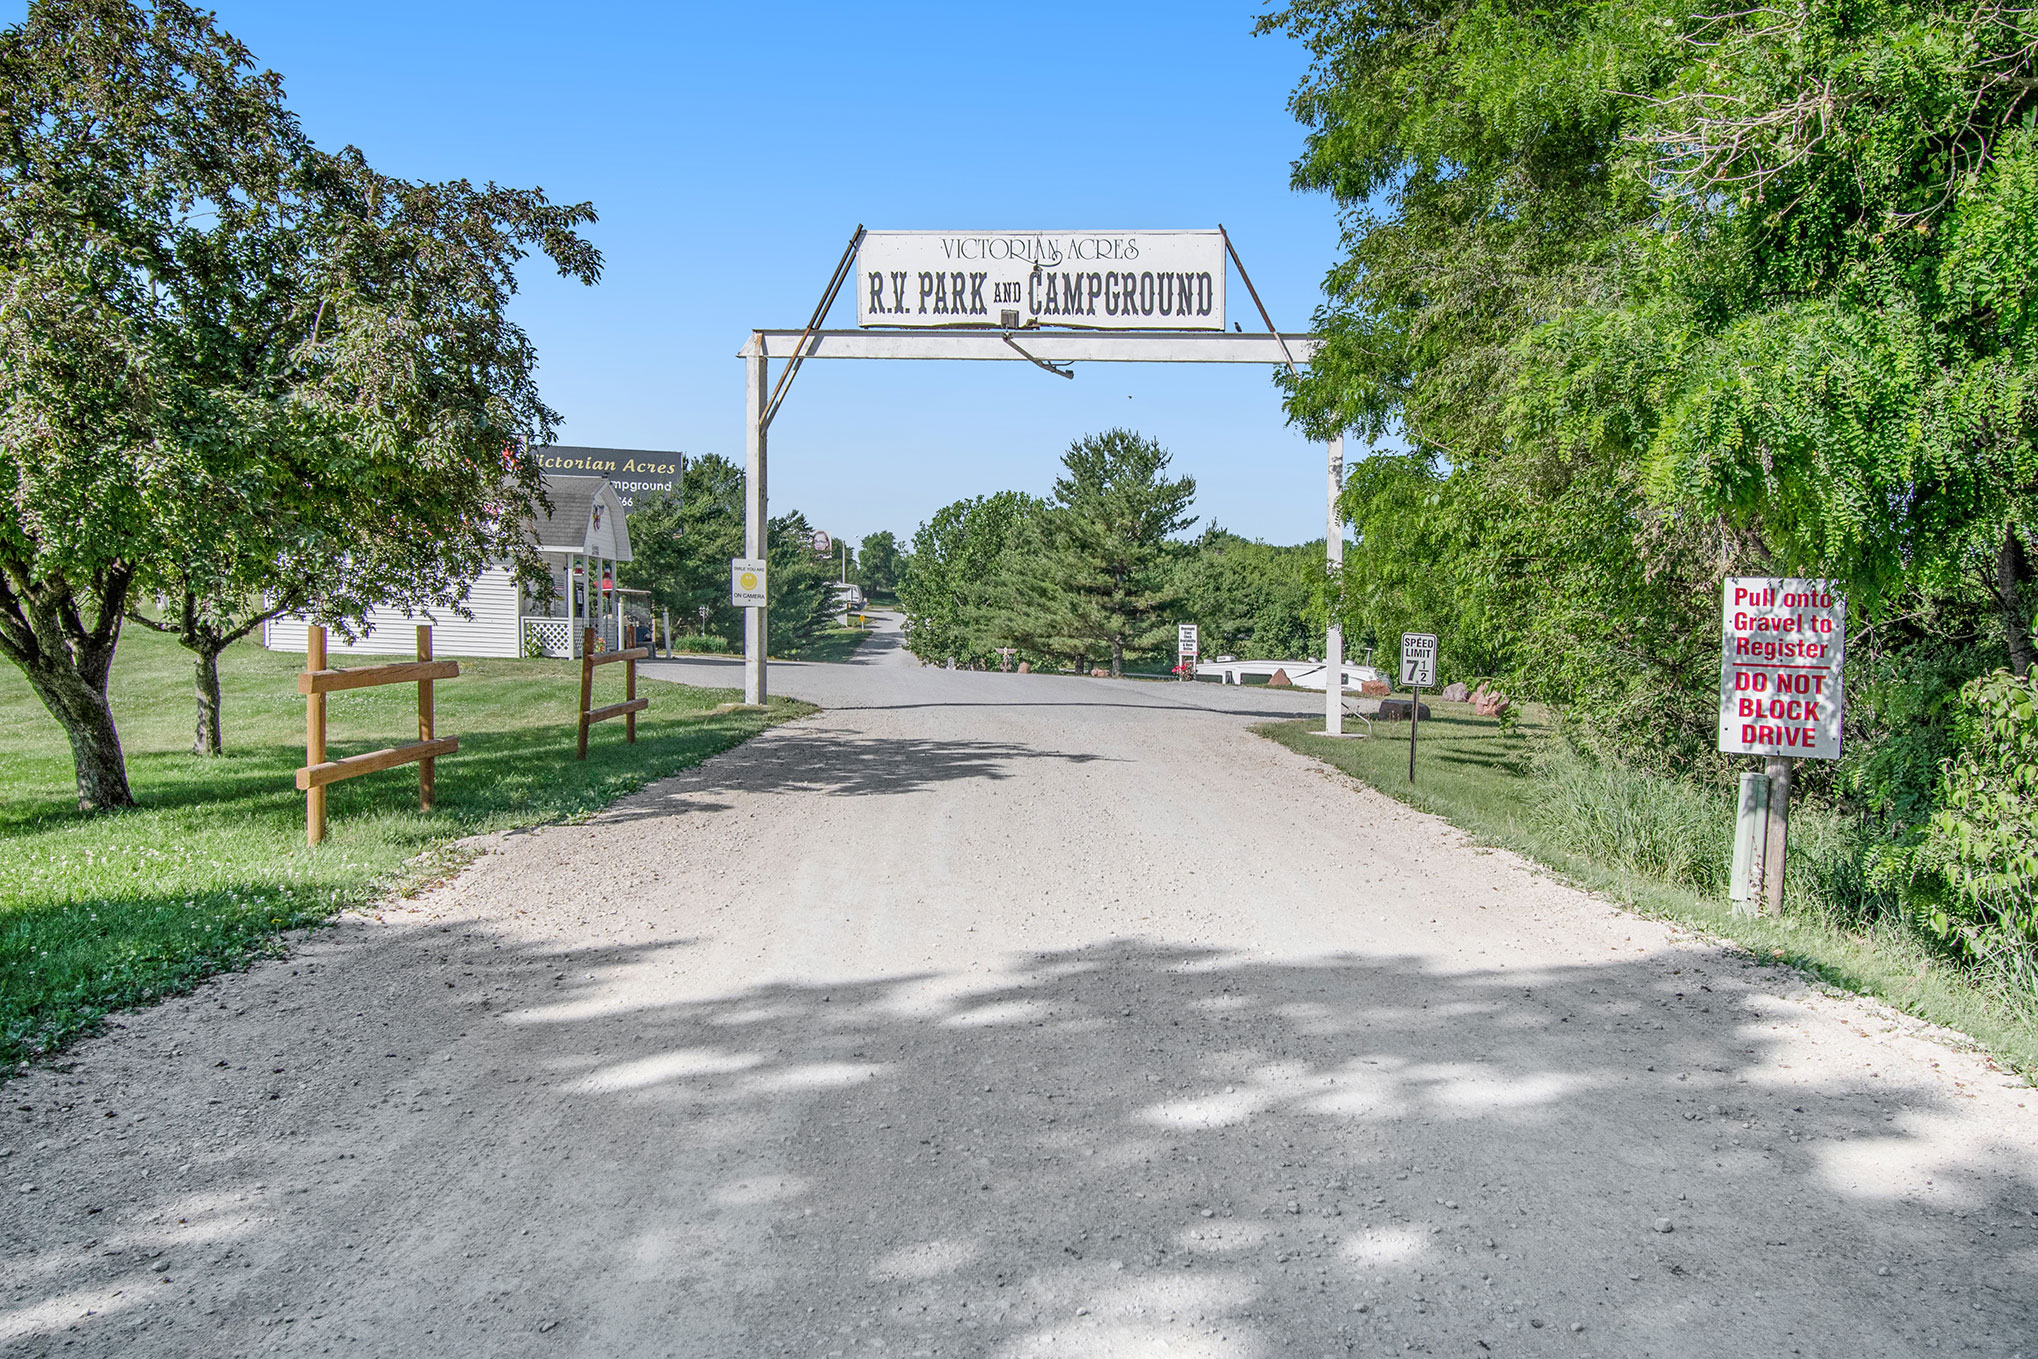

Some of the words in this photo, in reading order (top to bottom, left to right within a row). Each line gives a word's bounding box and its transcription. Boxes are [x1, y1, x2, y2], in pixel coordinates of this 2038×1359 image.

[942, 238, 1063, 267] VICTORIAN
[1067, 238, 1139, 260] ACRES
[868, 271, 911, 315] R.V.
[918, 271, 988, 315] PARK
[993, 281, 1021, 303] AND
[1028, 270, 1213, 316] CAMPGROUND
[535, 453, 616, 471] ictorian
[623, 458, 676, 474] Acres
[611, 480, 672, 492] mpground
[1734, 587, 1775, 607] Pull
[1783, 589, 1832, 608] onto
[1734, 612, 1802, 632] Gravel
[1811, 615, 1832, 633] to
[1404, 637, 1434, 648] SPEED
[1736, 637, 1828, 660] Register
[1405, 649, 1431, 658] LIMIT
[1735, 672, 1768, 692] DO
[1777, 673, 1827, 694] NOT
[1738, 698, 1820, 721] BLOCK
[1741, 724, 1816, 747] DRIVE
